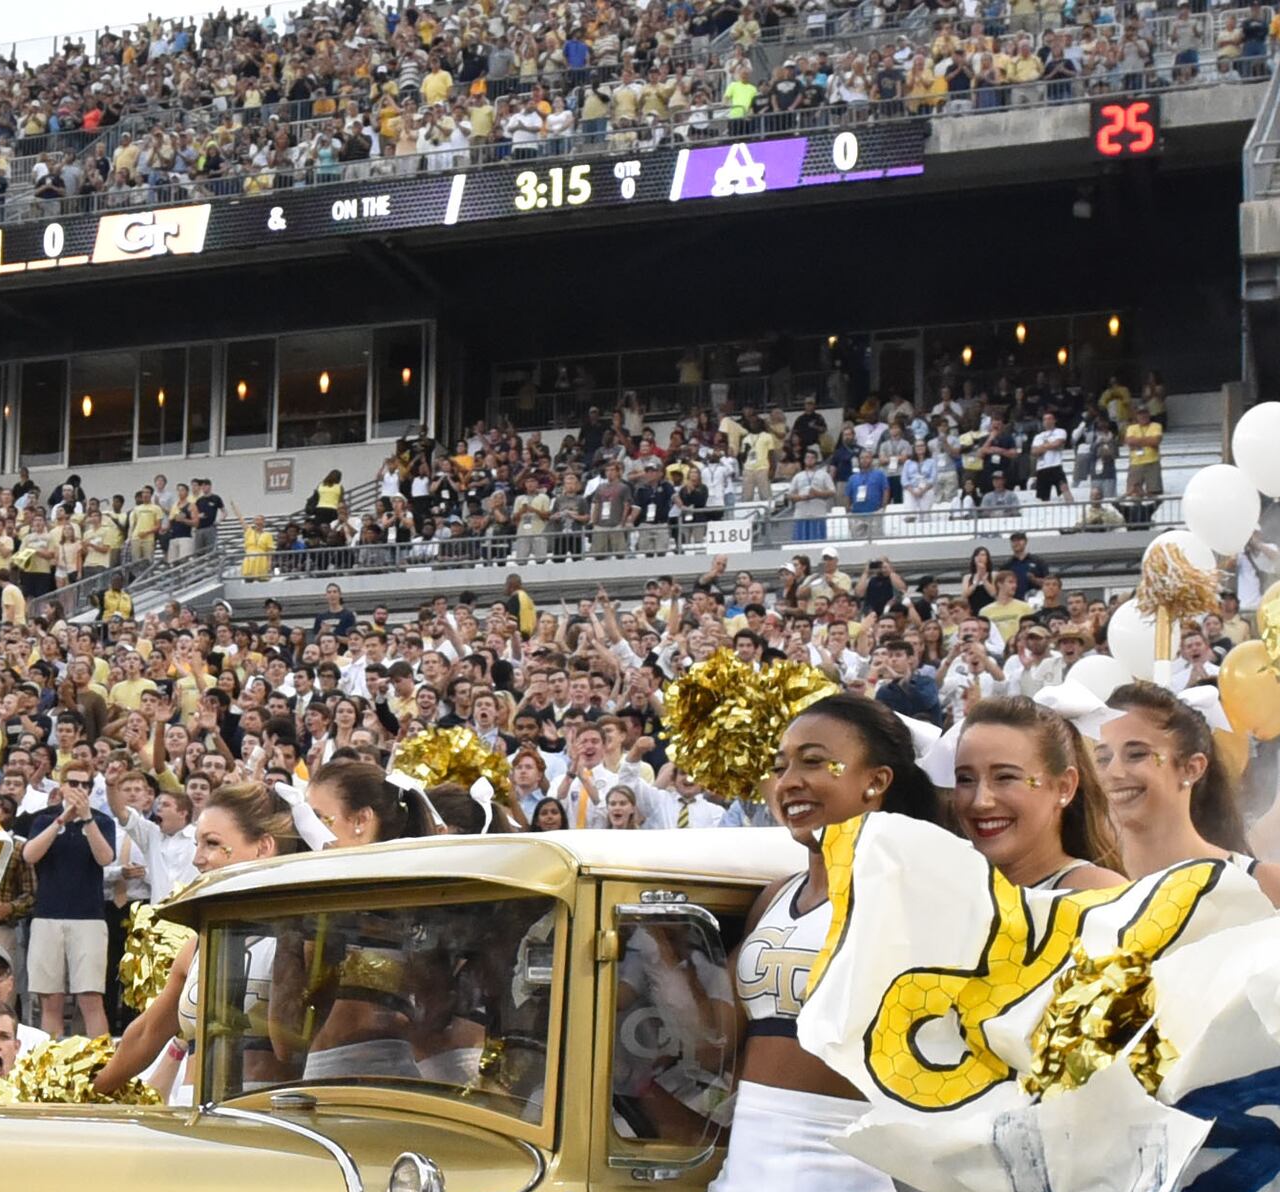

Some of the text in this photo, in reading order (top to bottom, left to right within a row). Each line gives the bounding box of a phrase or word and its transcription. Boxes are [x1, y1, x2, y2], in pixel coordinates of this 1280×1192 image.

[1096, 102, 1155, 156] 25
[832, 132, 859, 171] 0
[515, 164, 592, 210] 3:15
[267, 194, 391, 231] & ON THE
[43, 223, 65, 258] 0
[116, 211, 180, 257] GT
[269, 472, 290, 488] 117
[708, 528, 751, 544] 118U
[736, 926, 821, 1018] GT
